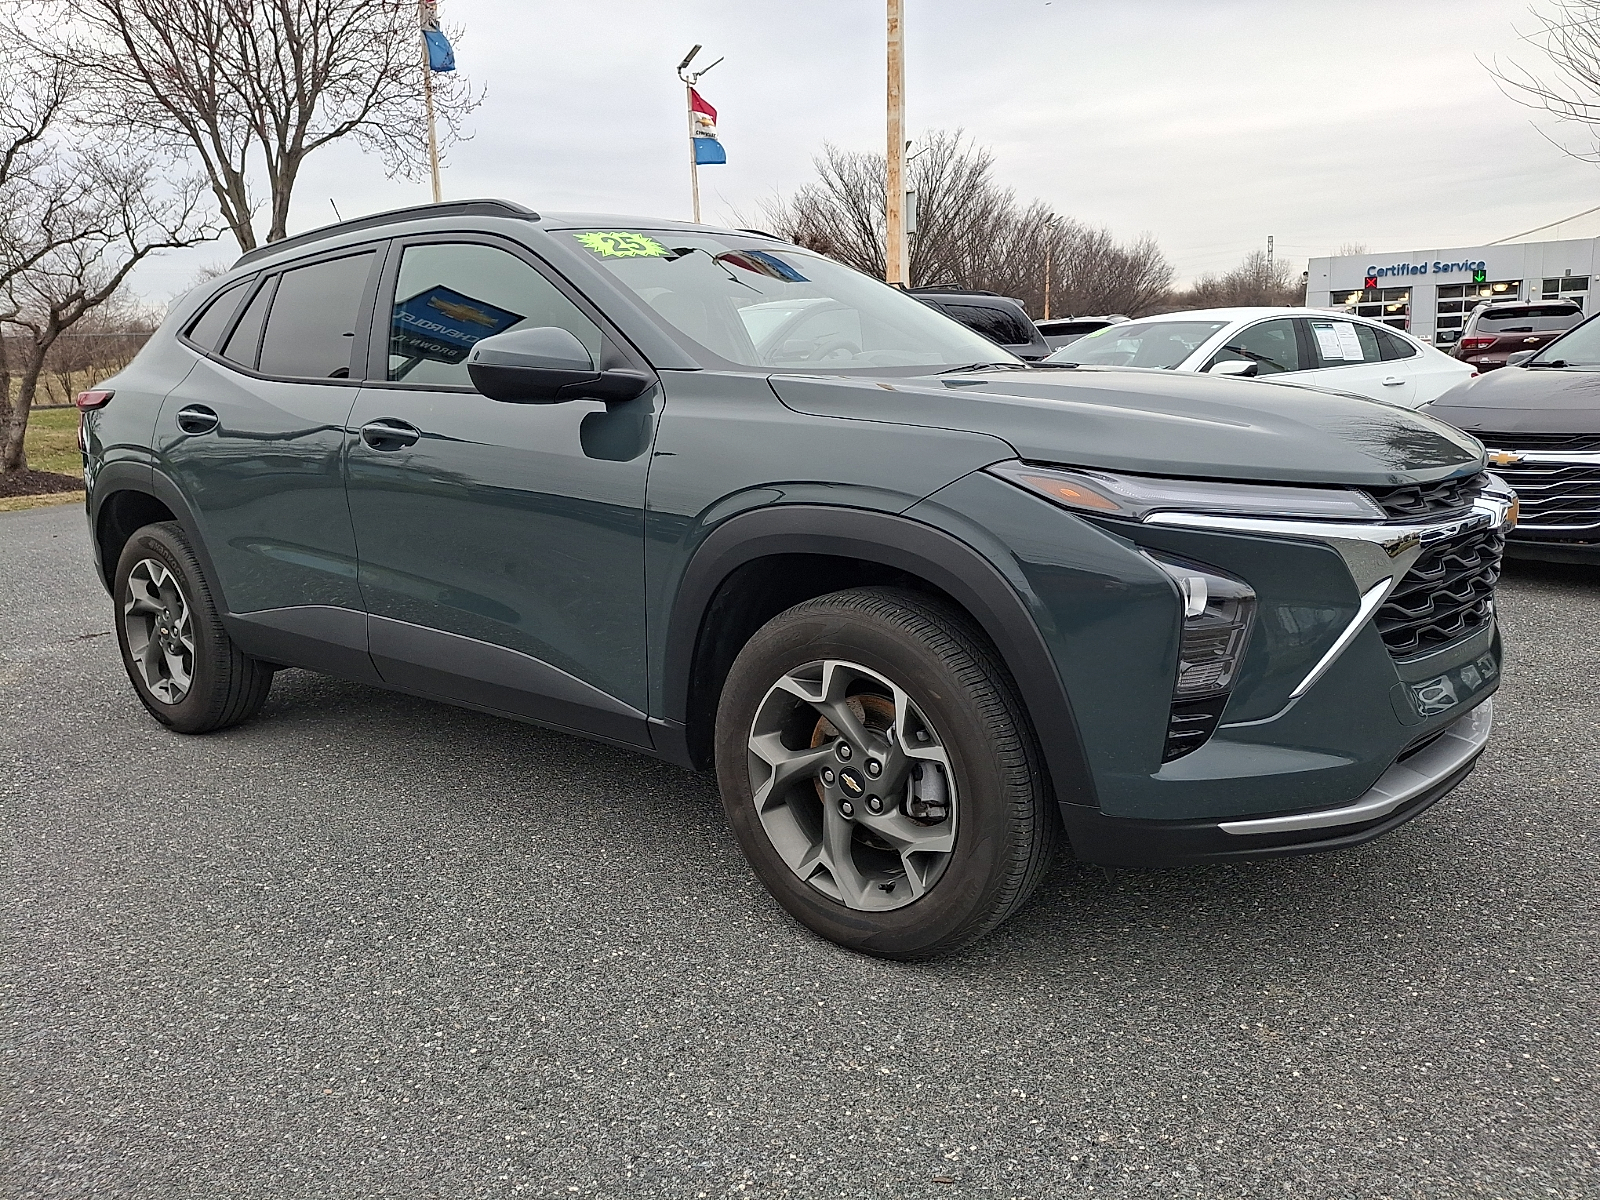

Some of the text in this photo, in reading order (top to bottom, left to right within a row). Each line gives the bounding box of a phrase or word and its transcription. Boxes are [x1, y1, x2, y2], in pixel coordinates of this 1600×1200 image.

[600, 236, 647, 252] 25
[1367, 260, 1486, 277] Certified Service
